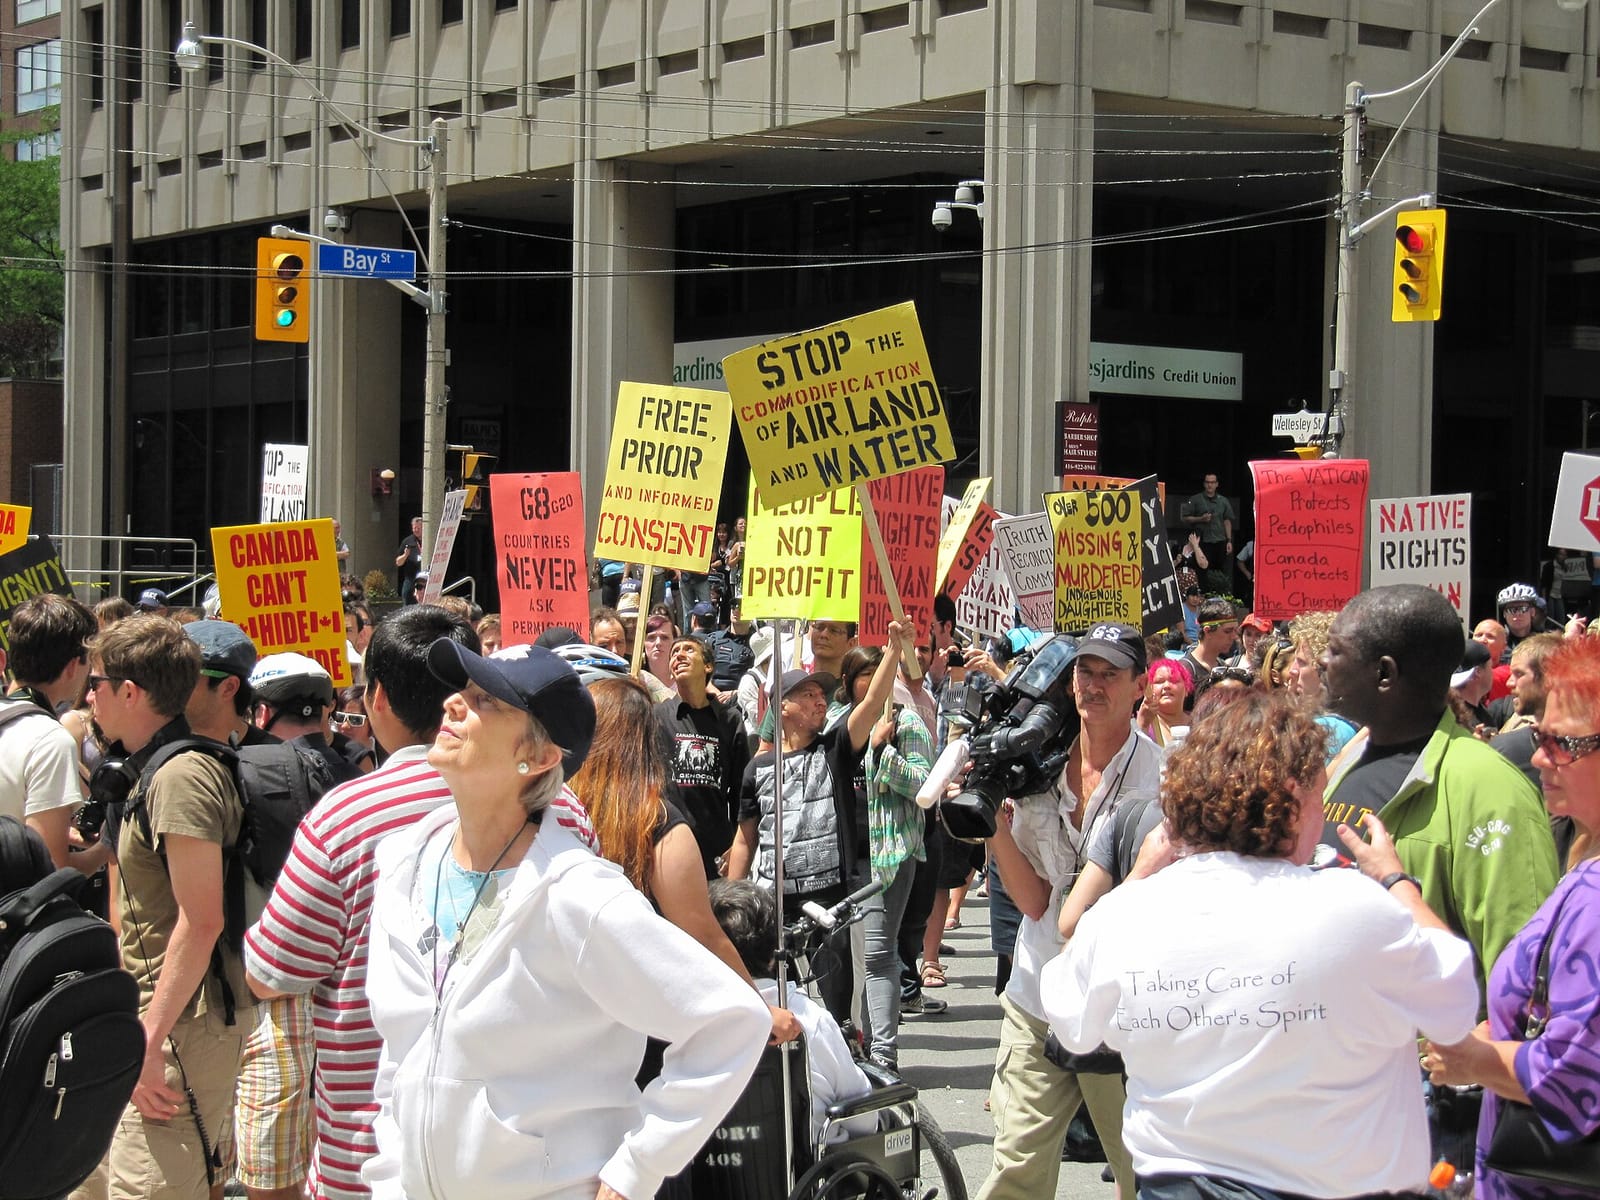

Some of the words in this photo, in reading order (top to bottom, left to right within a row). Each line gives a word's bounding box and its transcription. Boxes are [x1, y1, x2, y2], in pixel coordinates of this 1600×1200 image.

[343, 249, 378, 275] Bay
[381, 252, 391, 264] St
[673, 356, 723, 382] ardins
[757, 330, 851, 390] STOP
[865, 331, 905, 354] THE
[1089, 358, 1155, 382] sjardins
[1163, 369, 1199, 383] Credit
[1203, 372, 1237, 386] Union
[740, 361, 922, 423] COMMODIFICATION
[638, 396, 717, 442] FREE,
[756, 420, 781, 441] OF
[1064, 410, 1098, 426] Ralph's
[1274, 416, 1311, 432] Wellesley
[1313, 417, 1321, 430] St
[288, 462, 300, 473] THE
[620, 438, 703, 480] PRIOR
[770, 462, 808, 486] AND
[812, 424, 942, 488] WATER
[870, 473, 940, 507] NATIVE
[1261, 470, 1296, 485] The
[1301, 467, 1368, 485] VATICAN
[520, 487, 550, 520] G8
[551, 494, 574, 514] G20
[605, 484, 633, 501] AND
[639, 489, 714, 512] INFORMED
[753, 486, 861, 516] OPLE
[1085, 492, 1131, 527] 500
[1290, 490, 1350, 511] Protects
[1269, 515, 1354, 541] Pedophiles
[1380, 500, 1465, 533] NATIVE
[230, 528, 319, 568] CANADA
[504, 534, 570, 549] COUNTRIES
[598, 512, 714, 558] CONSENT
[777, 527, 832, 556] NOT
[1000, 525, 1048, 548] TRUTH
[1128, 531, 1139, 561] &
[888, 548, 908, 562] ARE
[1264, 550, 1329, 566] Canada
[1380, 537, 1466, 570] RIGHTS
[0, 557, 65, 610] IGNITY
[506, 552, 577, 592] NEVER
[748, 566, 854, 599] PROFIT
[867, 562, 930, 598] HMAN
[975, 567, 988, 578] RE
[1056, 563, 1142, 591] MURDERED
[1281, 568, 1349, 589] protects
[247, 570, 308, 608] CAN'T
[962, 576, 1009, 609] UMAN
[1066, 588, 1122, 602] INDIGENOUS
[1261, 594, 1283, 610] the
[1288, 592, 1348, 609] Churche
[529, 598, 554, 613] ASK
[865, 602, 928, 639] RIGTS
[958, 599, 1011, 635] IGHTS
[258, 610, 311, 647] HIDE
[1323, 803, 1373, 827] PIRIT
[1125, 969, 1200, 998] Taking
[1205, 967, 1264, 994] Care
[1271, 961, 1296, 986] of
[1117, 1007, 1161, 1032] Each
[1166, 1005, 1249, 1031] Other's
[1256, 1001, 1328, 1032] Spirit
[886, 1133, 911, 1150] drive
